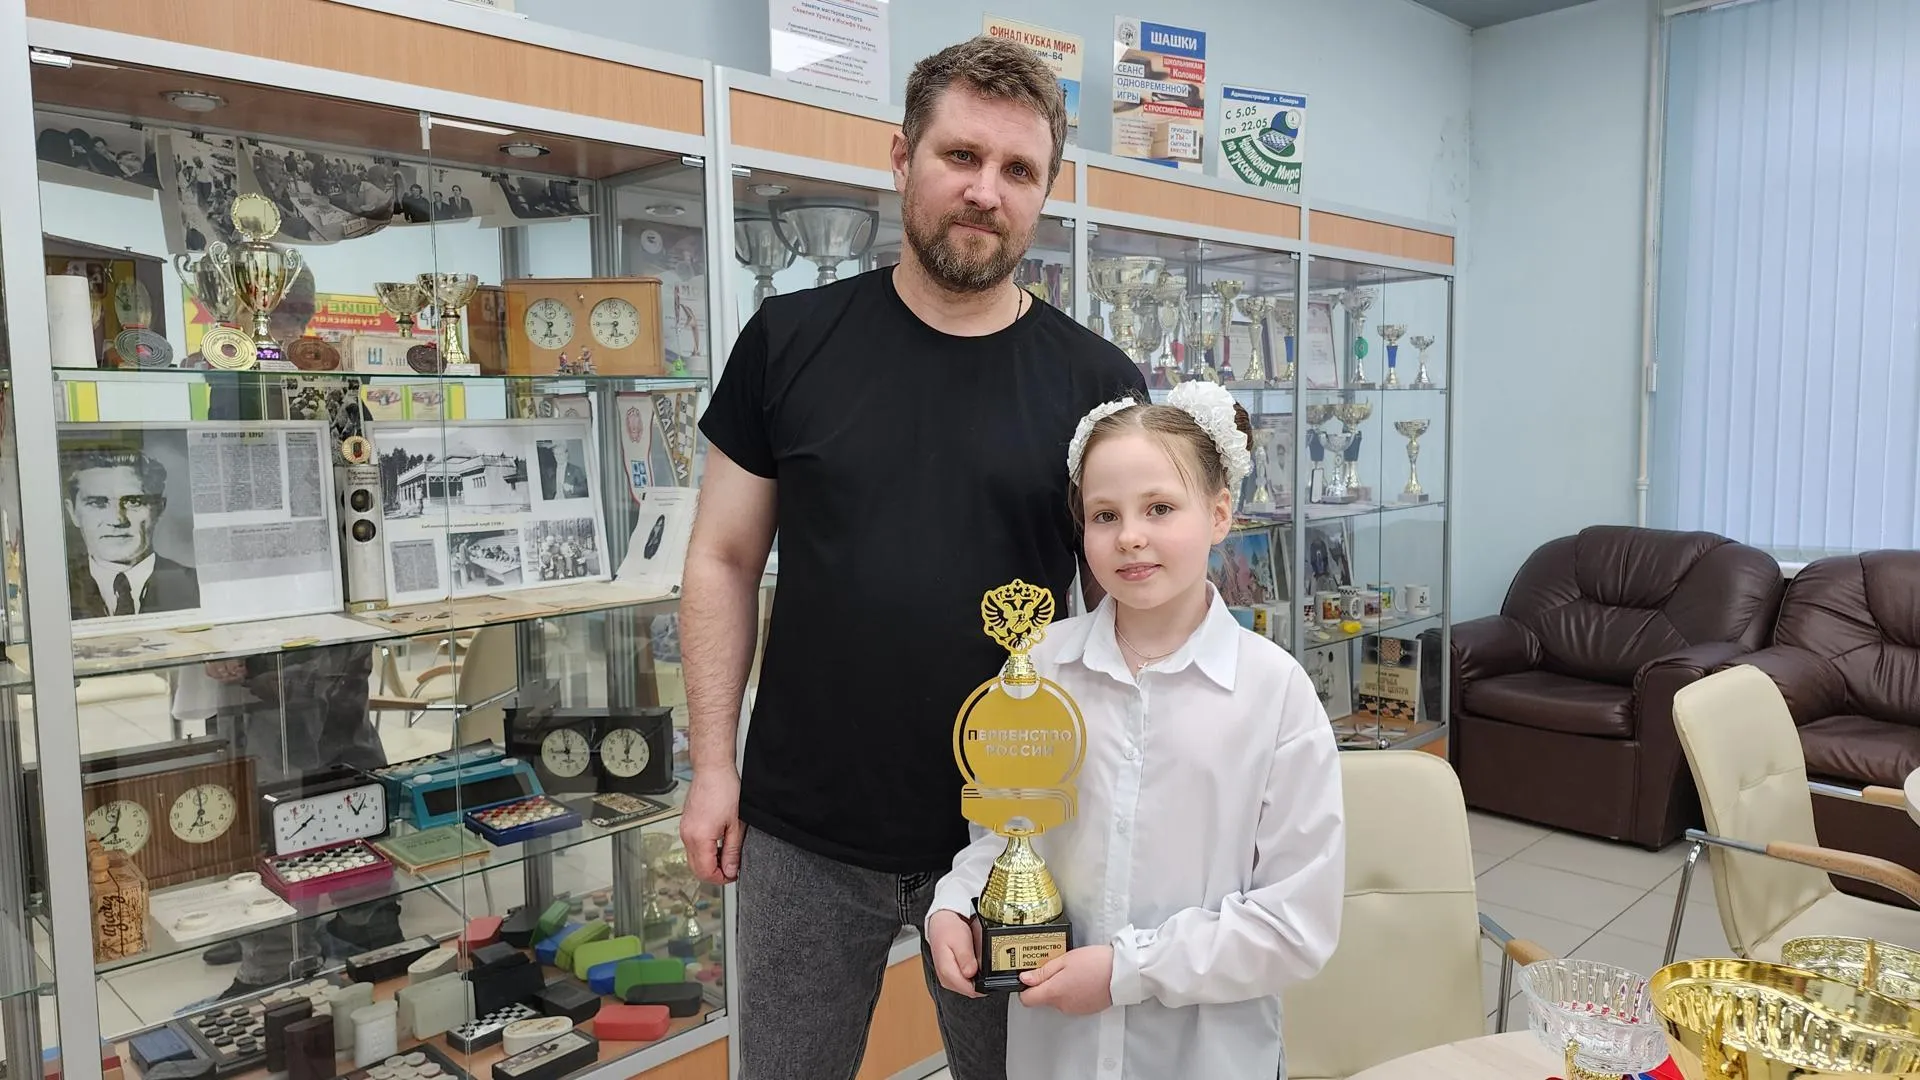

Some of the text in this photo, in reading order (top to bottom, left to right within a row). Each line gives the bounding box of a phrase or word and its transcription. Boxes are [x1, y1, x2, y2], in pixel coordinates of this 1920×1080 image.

[990, 25, 1076, 55] ФИНАЛ КУБКА МИРА
[1150, 31, 1198, 51] ШАШКИ
[1117, 64, 1144, 76] СЕАНС
[1117, 78, 1188, 94] ОДНОВРЕМЕННОЙ
[1117, 91, 1139, 101] ИГРЫ
[1143, 103, 1202, 118] С ГРОССМЕЙСТЕРАМИ
[1236, 105, 1257, 119] 5.05
[1224, 118, 1268, 136] по 22.05
[1226, 141, 1237, 151] по
[1238, 136, 1300, 184] Чемпионат Мира
[1228, 151, 1263, 187] Русским
[656, 397, 689, 480] ШАШИ
[968, 729, 1072, 741] ПЕРВЕНСТВО
[986, 745, 1055, 757] РОССИИ
[1022, 944, 1062, 952] ПЕРВЕНСТВО
